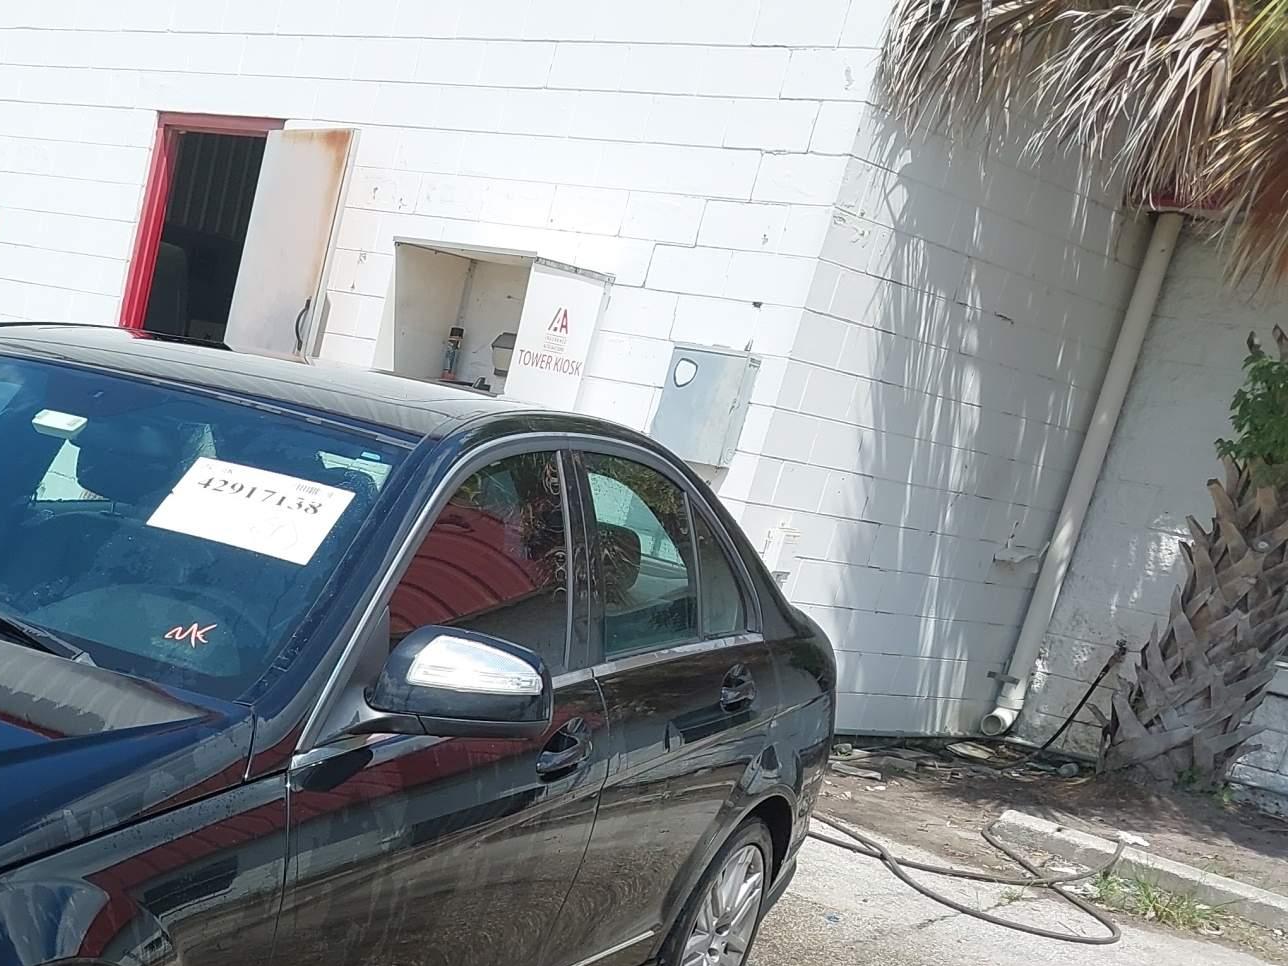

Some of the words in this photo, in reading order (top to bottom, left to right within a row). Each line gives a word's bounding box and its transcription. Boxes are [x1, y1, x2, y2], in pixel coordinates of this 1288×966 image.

[518, 349, 553, 370] TOWER
[553, 357, 583, 376] KIOSK
[198, 476, 322, 515] 42917138
